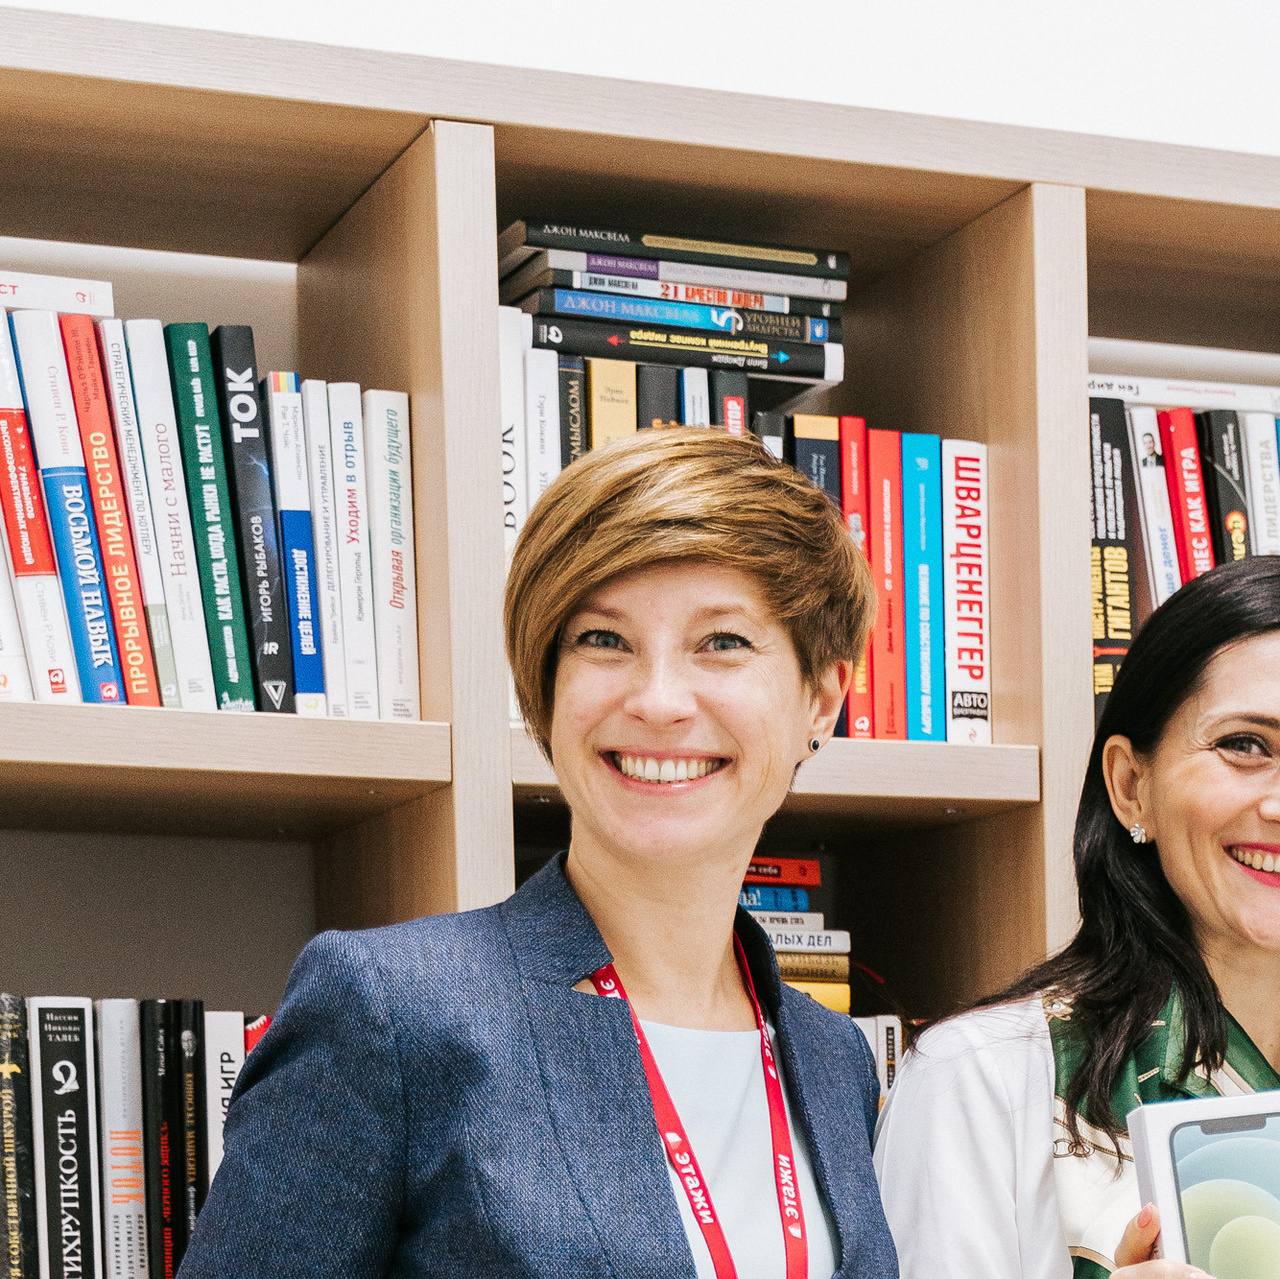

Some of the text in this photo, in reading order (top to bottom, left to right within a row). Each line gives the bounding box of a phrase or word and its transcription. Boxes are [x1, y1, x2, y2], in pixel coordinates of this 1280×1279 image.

[564, 295, 700, 322] ДЖОН МАКСВЕЛЛ
[658, 281, 678, 299] 21
[629, 329, 768, 352] Внутренний компас лидера
[48, 365, 61, 409] Стивен
[57, 425, 72, 455] Кови
[111, 342, 154, 555] СТРАТЕГИЧЕСКИЙ МЕНЕДЖМЕНТ ПО КОТЛЕРУ
[225, 364, 260, 443] ТОК
[0, 419, 34, 565] ВЫСОКОЭФФЕКТИВНЫХ ЛЮДЕЙ
[19, 471, 34, 519] НАВЫКОВ
[155, 422, 187, 577] Начни с малого
[195, 423, 233, 620] КАК РАСТИ, КОГДА РЫНКИ НЕ РАСТУТ
[318, 445, 335, 592] ДЕЛЕГИРОВАНИЕ И УПРАВЛЕНИЕ
[342, 421, 360, 543] Уходим в отрыв
[381, 408, 407, 609] Открывая организации будущего
[1180, 446, 1205, 533] КАК ИГРА
[1258, 439, 1278, 538] ЛИДЕРСТВА
[58, 481, 114, 669] ВОСЬМОЙ НАВЫК
[89, 430, 149, 695] ПРОРЫВНОЕ ЛИДЕРСТВО
[250, 515, 273, 622] ИГОРЬ РЫБАКОВ
[954, 456, 985, 681] ШВАРЦЕНЕГГЕР
[1159, 525, 1175, 567] денег
[290, 547, 316, 655] ДОСТИЖЕНИЕ ЦЕЛЕЙ
[1104, 546, 1131, 641] ГИГАНТОВ
[953, 692, 987, 708] АВТО
[807, 934, 832, 947] ДЕЛ
[48, 1033, 79, 1042] ТАЛЕБ
[220, 1051, 235, 1089] ИГР
[2, 1157, 21, 1265] СОБСТВЕННОЙ
[109, 1129, 145, 1205] ПОТОК
[674, 1151, 714, 1225] этажи
[784, 1152, 801, 1221] этажи
